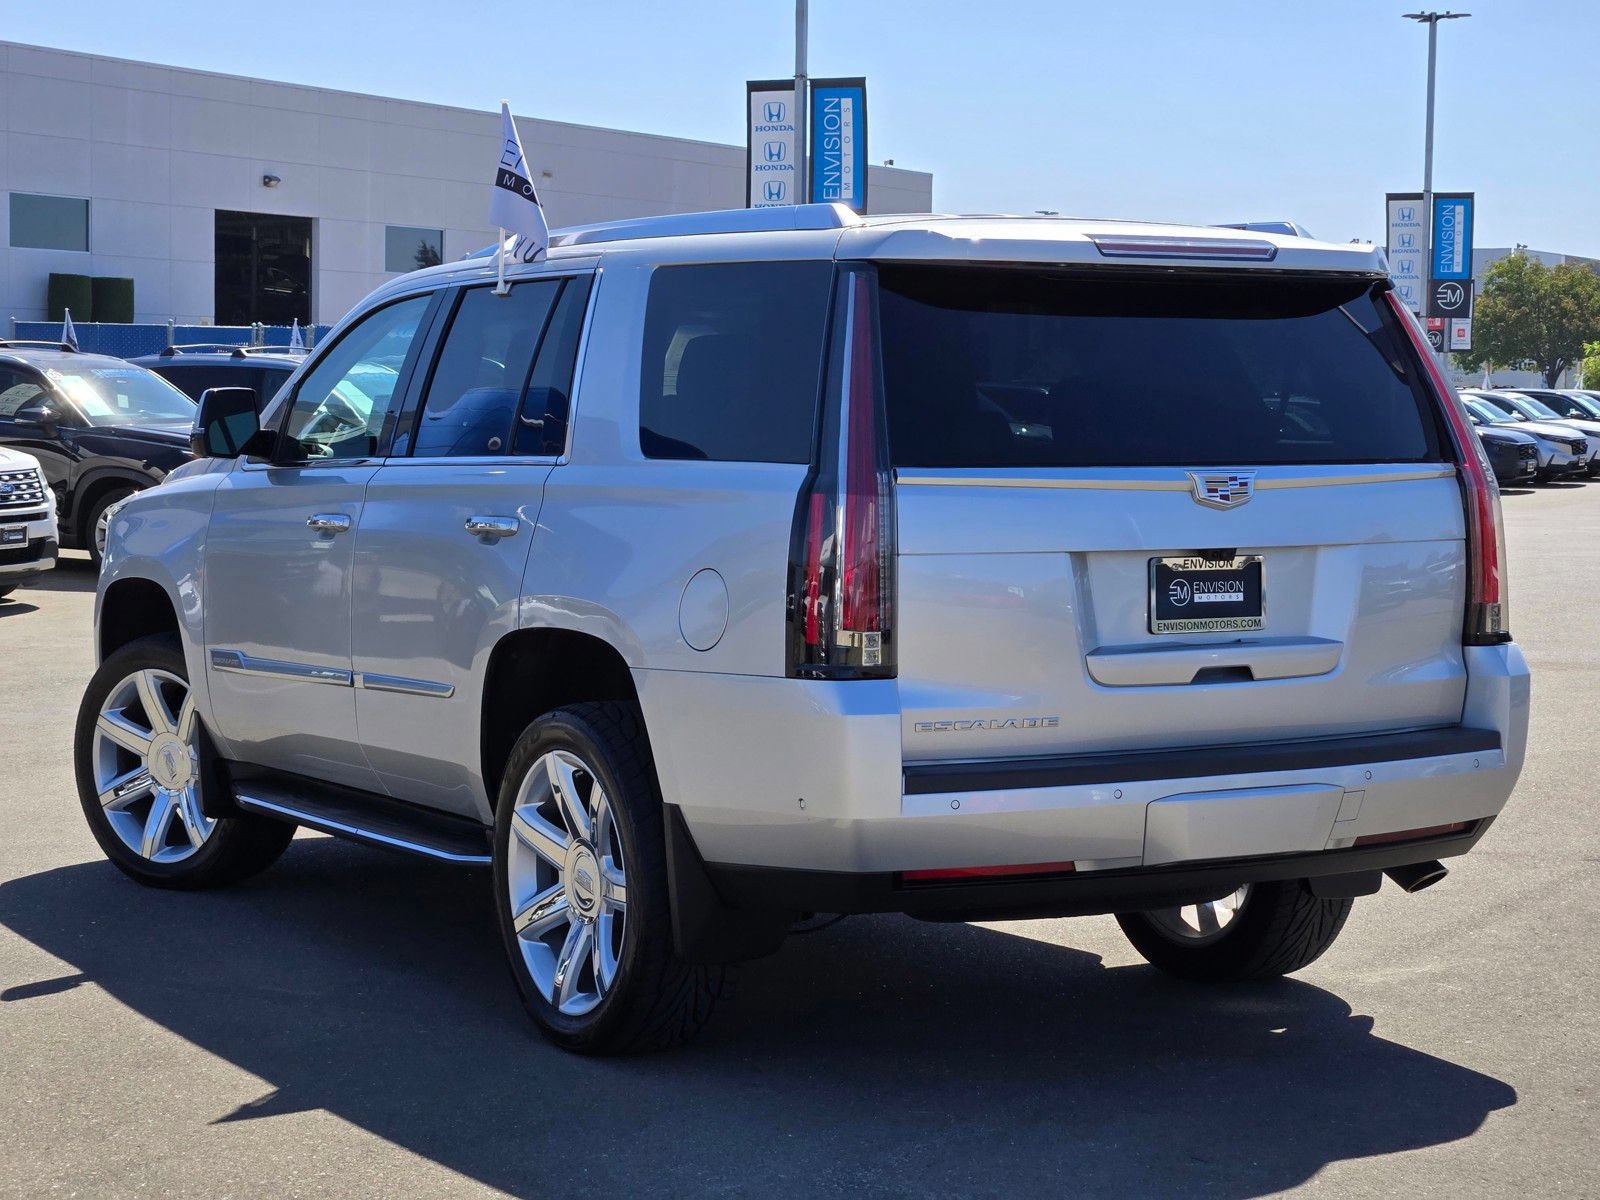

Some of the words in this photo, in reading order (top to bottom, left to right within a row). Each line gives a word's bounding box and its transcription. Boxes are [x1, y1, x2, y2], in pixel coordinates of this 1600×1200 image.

[824, 98, 840, 200] ENVISION
[843, 107, 852, 190] MOTORS
[1440, 204, 1454, 272] ENVISION
[1183, 558, 1234, 569] ENVISION
[1194, 580, 1244, 593] ENVISION
[1157, 619, 1261, 632] ENVISIONMOTORS.COM
[914, 716, 1060, 732] ESCALADE
